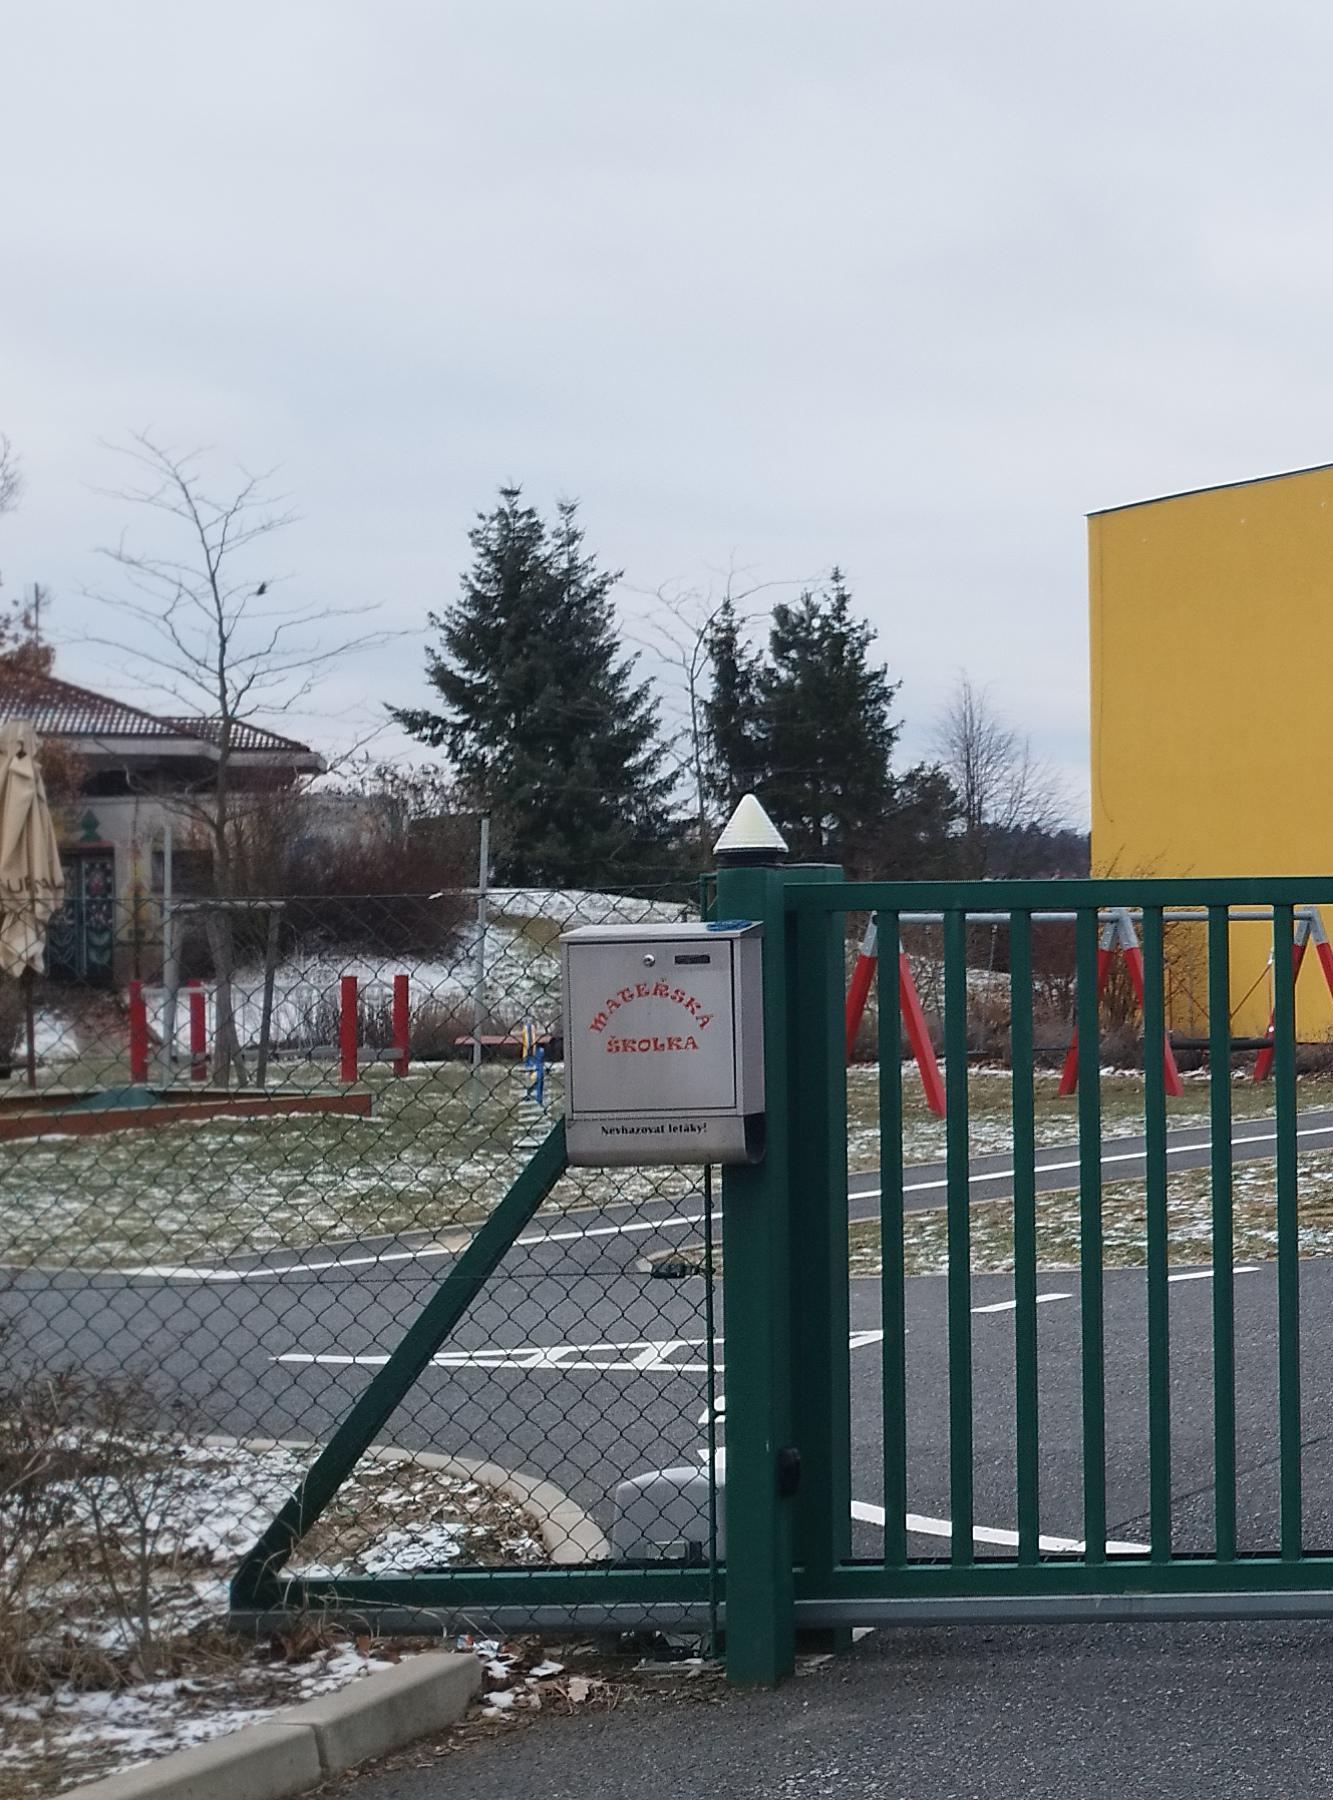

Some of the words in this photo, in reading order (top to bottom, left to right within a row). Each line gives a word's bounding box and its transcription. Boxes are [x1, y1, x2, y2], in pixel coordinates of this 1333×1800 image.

[588, 977, 714, 1033] MATEŘSKÁ
[606, 1035, 700, 1053] ŠKOLKA
[601, 1124, 665, 1135] Nevhazovat
